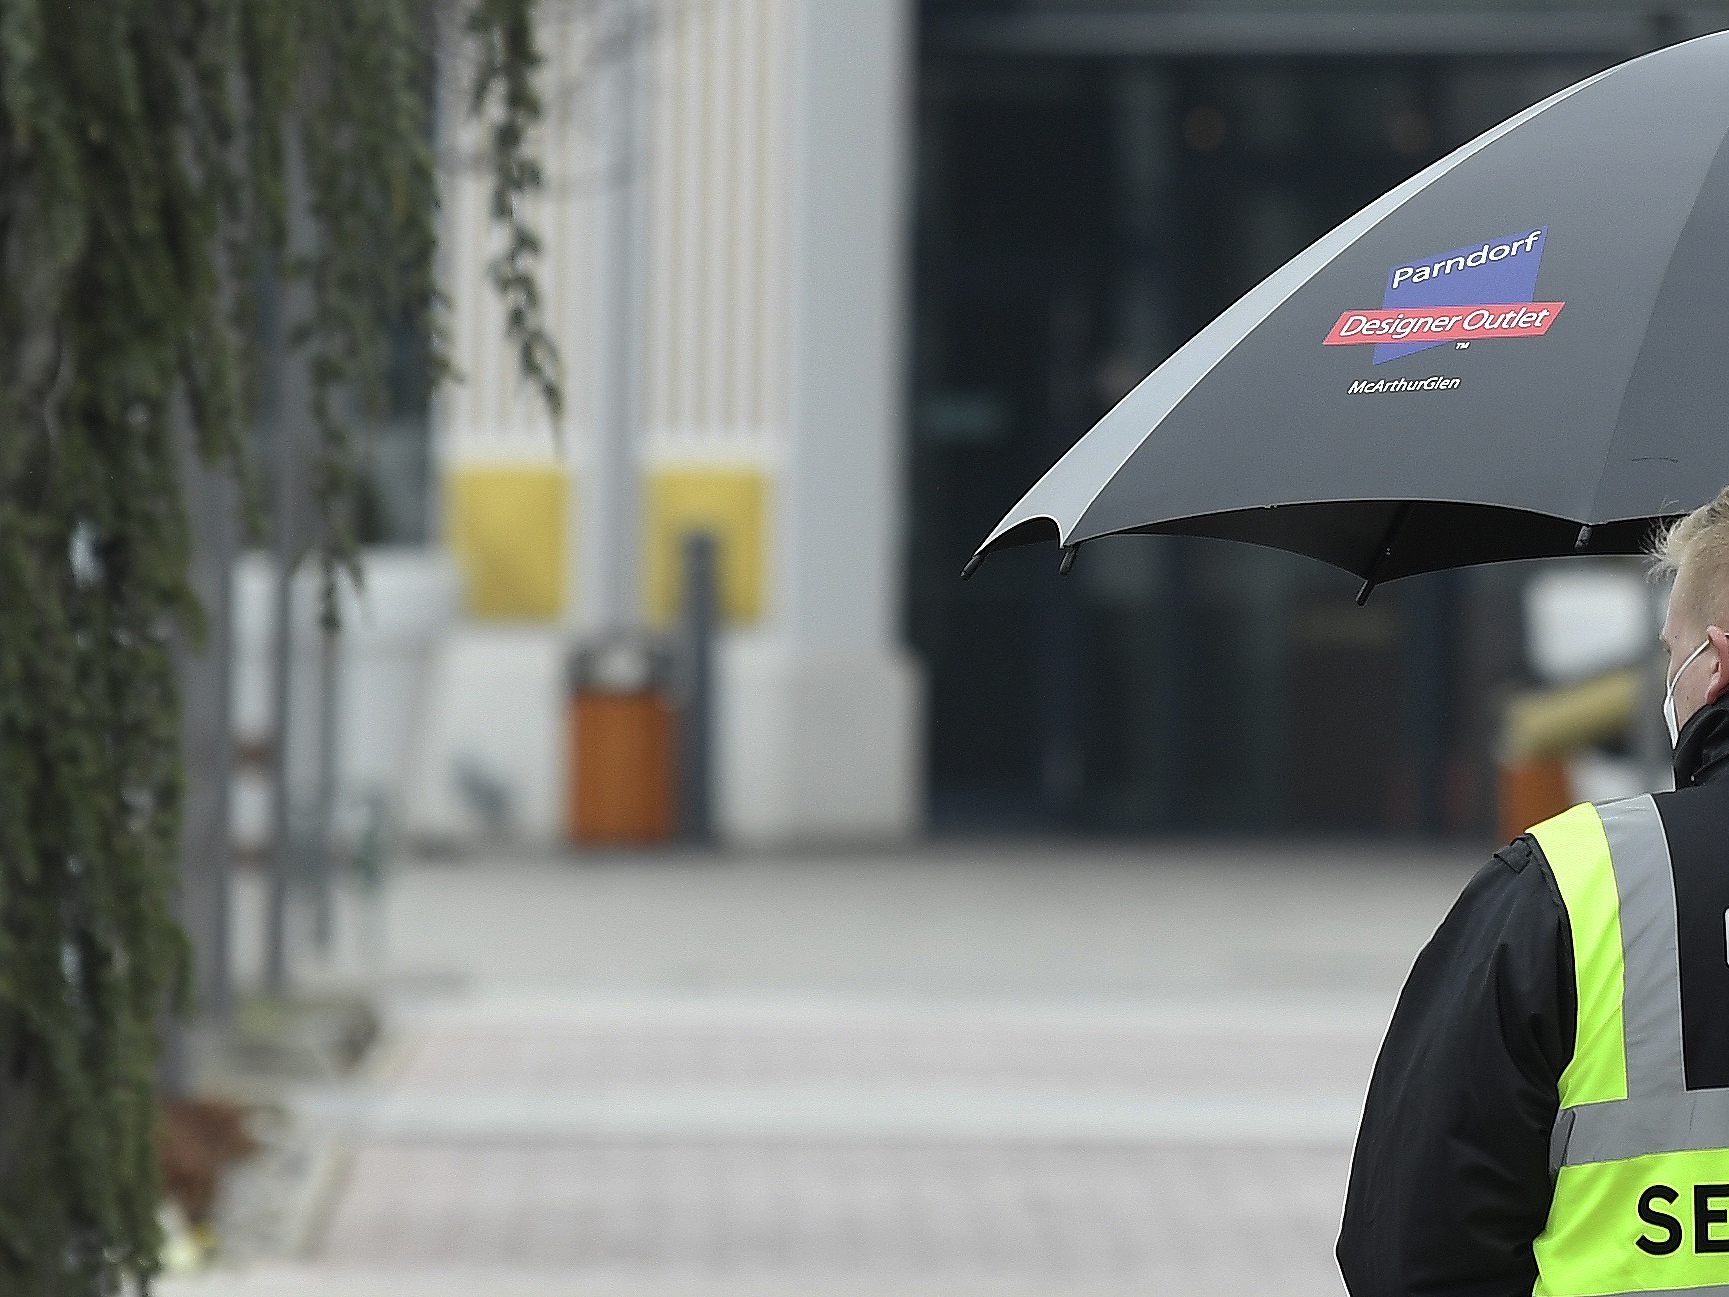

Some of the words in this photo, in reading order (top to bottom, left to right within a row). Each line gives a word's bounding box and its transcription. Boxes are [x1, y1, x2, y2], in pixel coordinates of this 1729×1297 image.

[1391, 230, 1542, 289] Parndorf
[1339, 313, 1464, 339] Designer
[1461, 307, 1550, 331] Outlet
[1347, 376, 1461, 395] McArthurGlen
